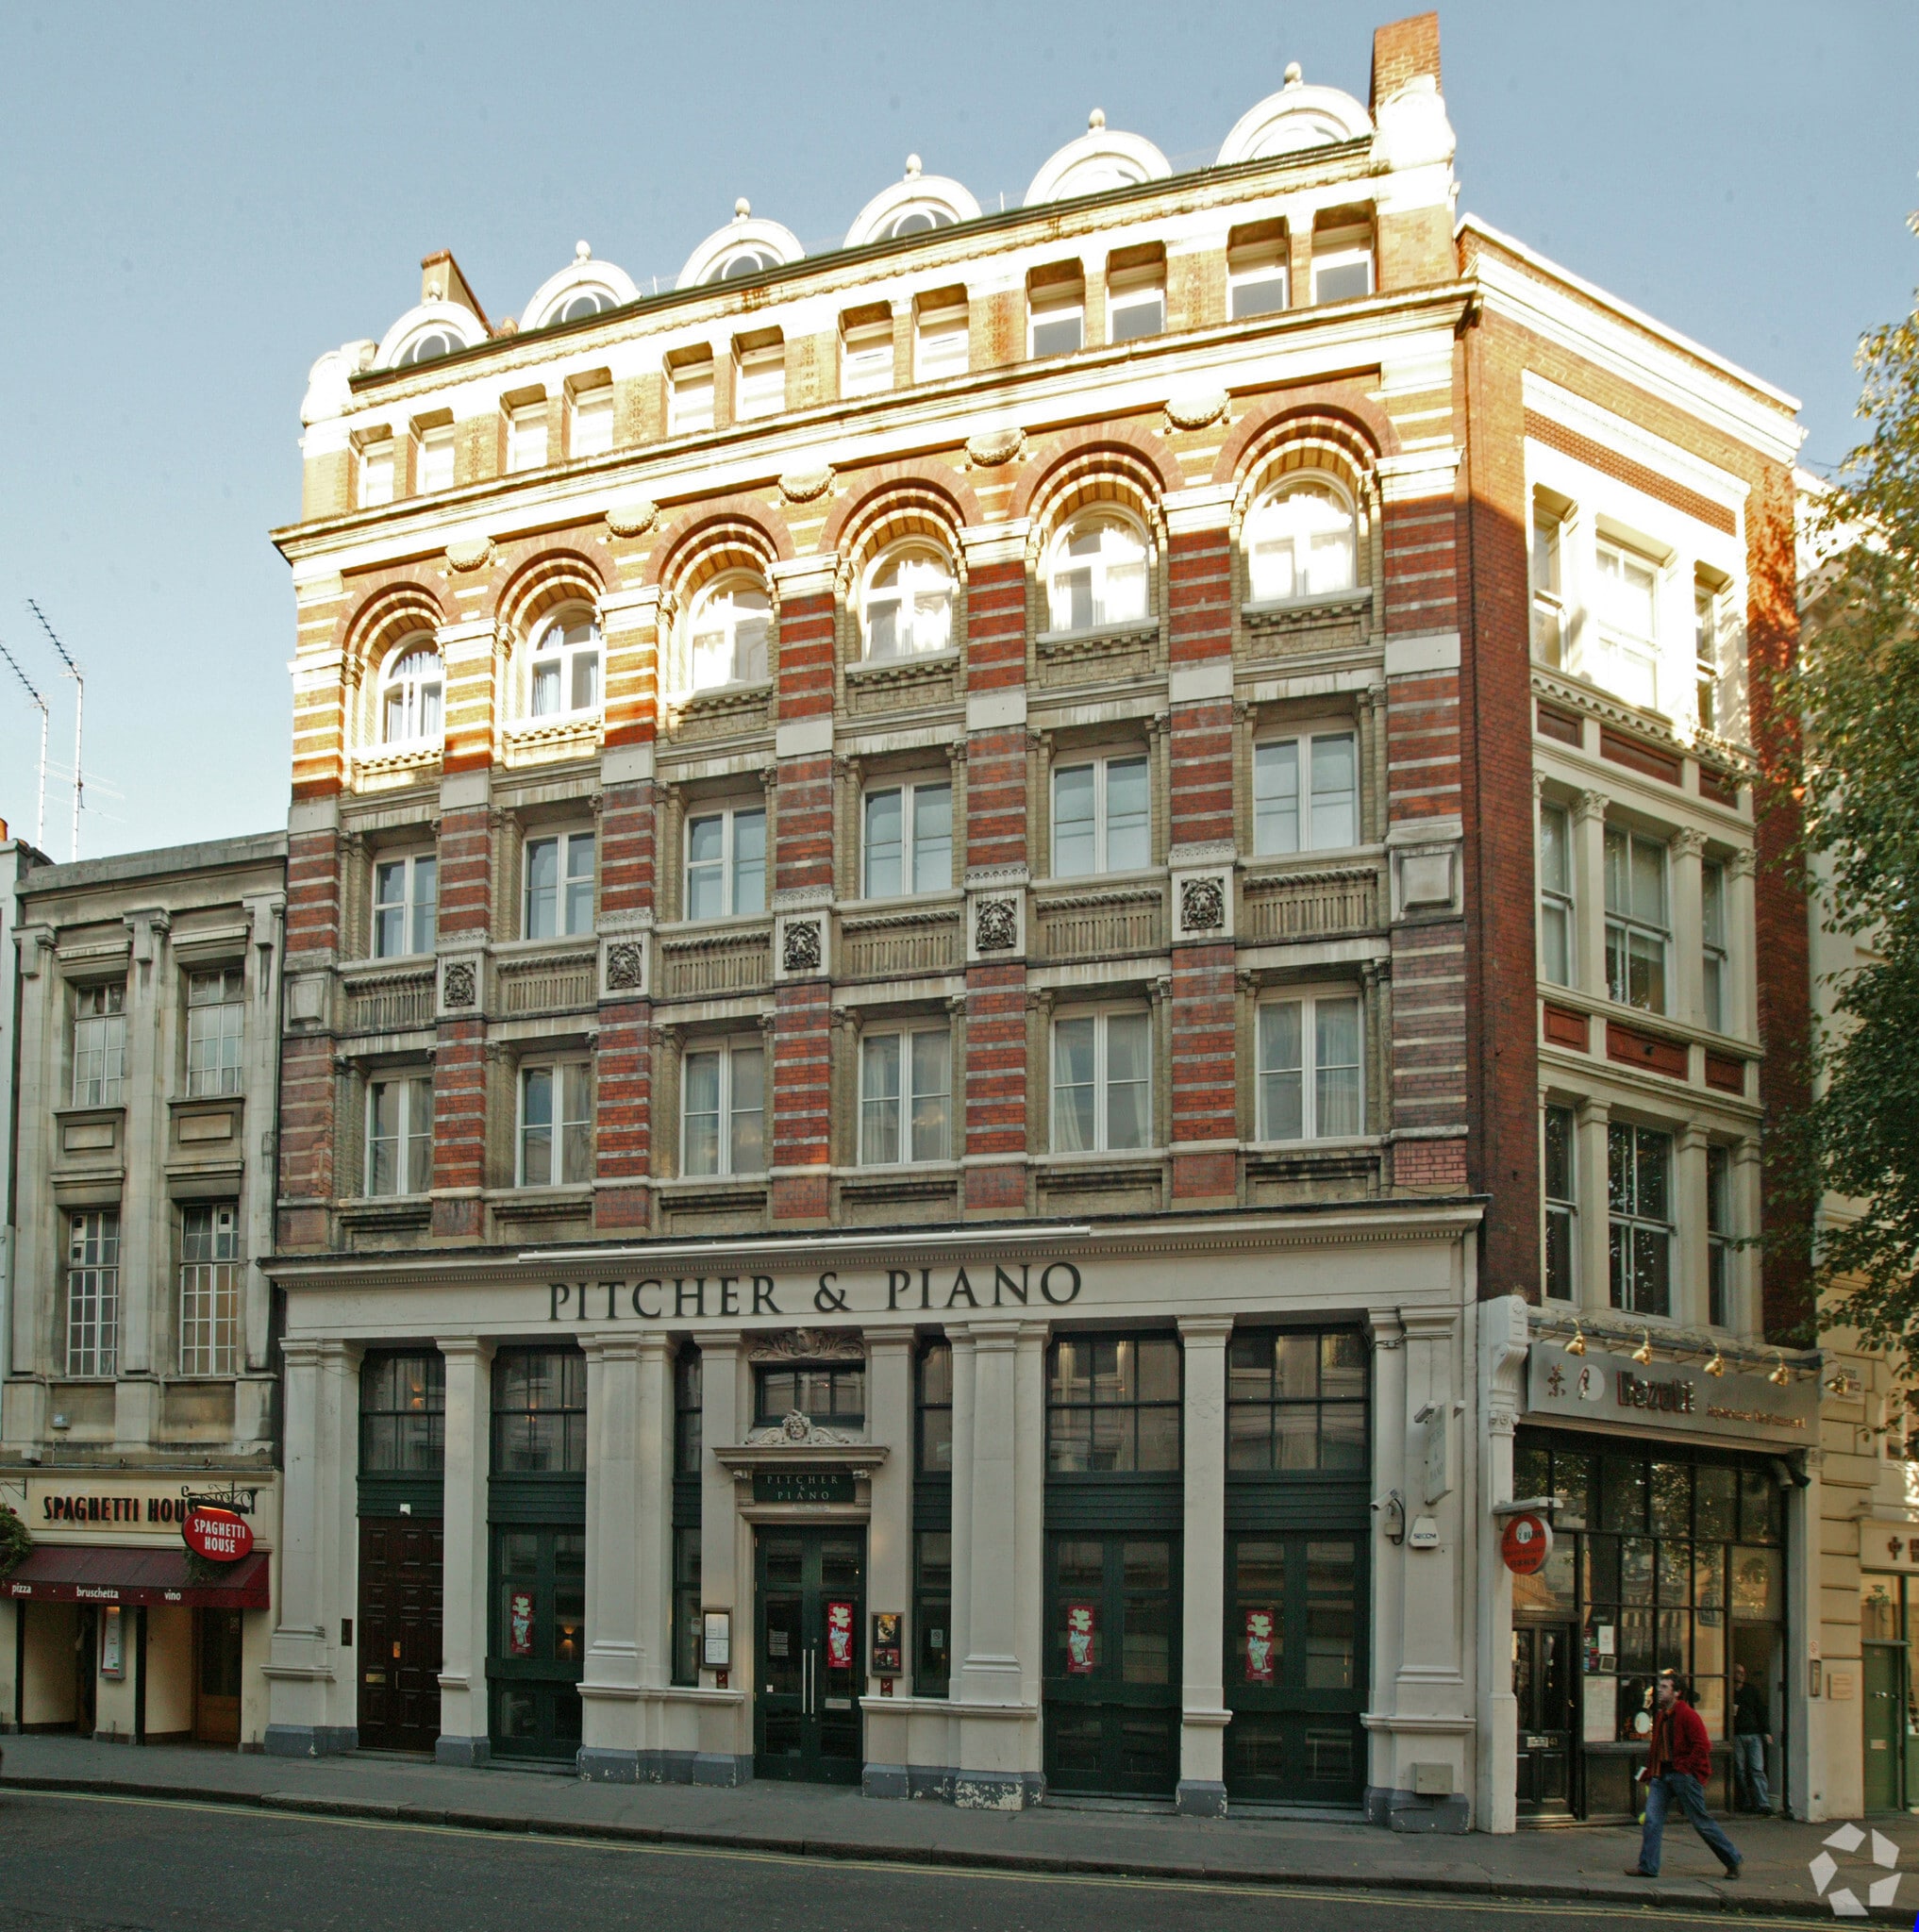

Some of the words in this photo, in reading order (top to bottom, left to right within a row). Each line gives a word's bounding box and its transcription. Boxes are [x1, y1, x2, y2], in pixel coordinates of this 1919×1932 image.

[547, 1275, 783, 1321] PITCHER
[813, 1272, 852, 1312] &
[885, 1261, 1082, 1309] PIANO
[767, 1475, 839, 1485] PITCHER
[777, 1491, 830, 1500] PIANO
[43, 1496, 140, 1522] SPAGHETTI
[147, 1498, 196, 1523] HOU
[193, 1518, 246, 1539] SPAGHETTI
[1413, 1531, 1438, 1540] SECOM
[204, 1537, 236, 1554] HOUSE
[11, 1583, 32, 1595] pizza
[76, 1586, 119, 1599] bruschetta
[164, 1589, 181, 1601] vino
